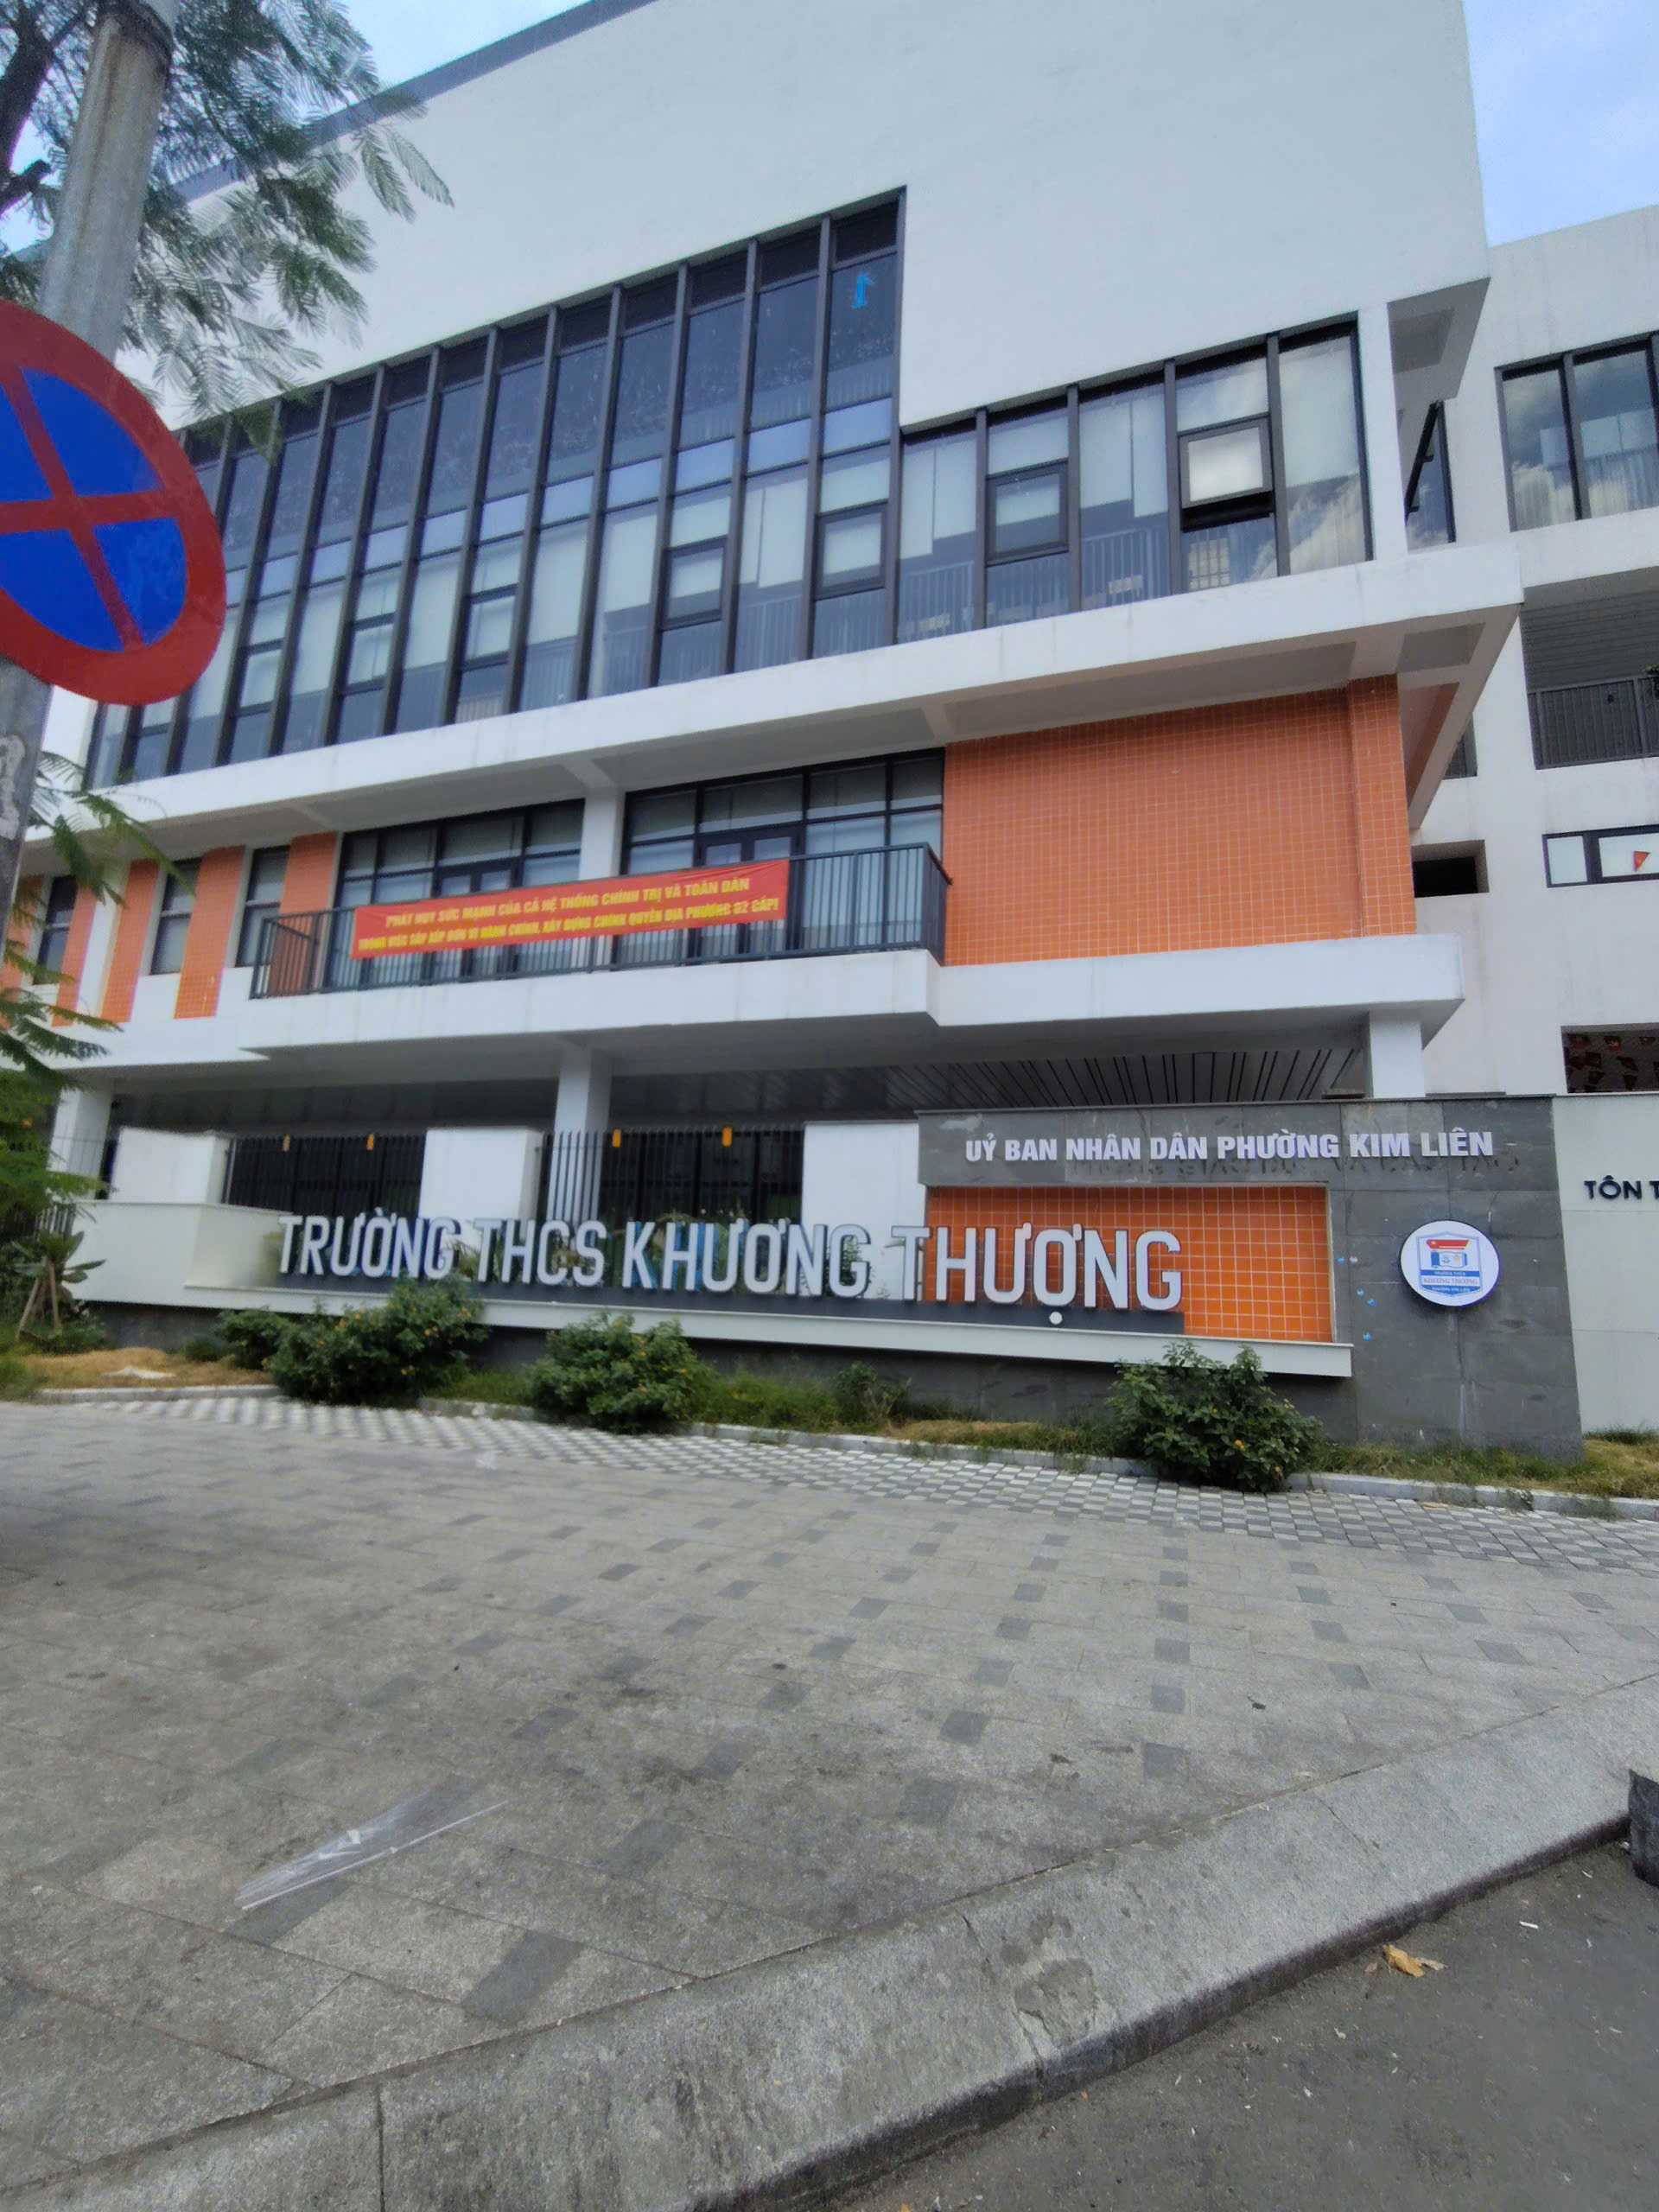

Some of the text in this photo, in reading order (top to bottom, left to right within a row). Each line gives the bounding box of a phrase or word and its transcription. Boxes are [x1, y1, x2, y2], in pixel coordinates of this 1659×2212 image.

[560, 893, 599, 909] THỐNG
[601, 889, 639, 906] CHÍNH
[642, 887, 662, 903] TRỊ
[683, 880, 719, 897] TOÀN
[965, 1127, 1494, 1161] UỶ BAN NHÂN DÂN PHƯỜNG KIM LIÊN
[1583, 1174, 1643, 1200] TÔN
[278, 1206, 1183, 1325] TRƯỜNG THCS KHƯƠNG THƯỢNG
